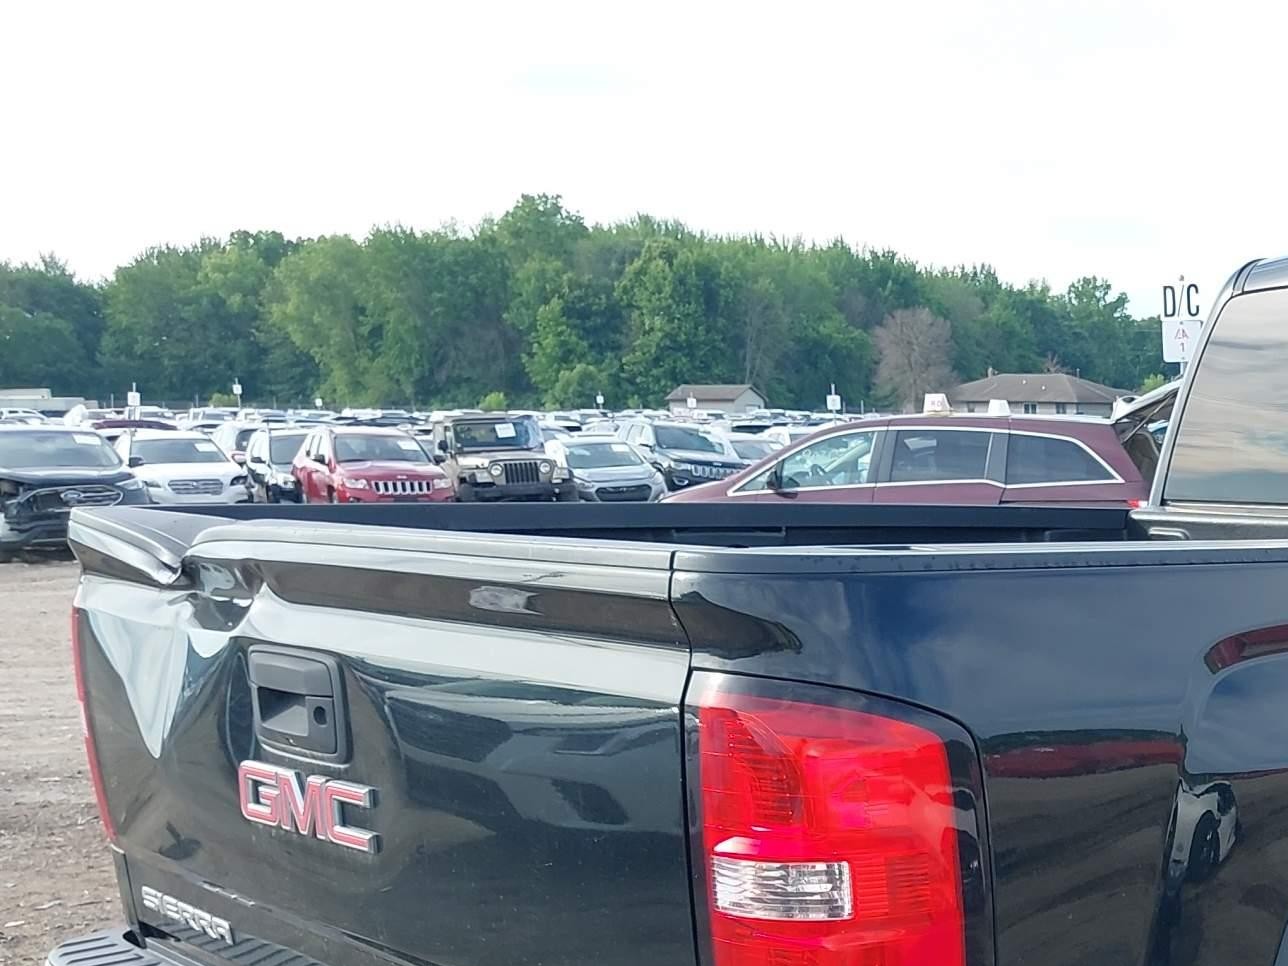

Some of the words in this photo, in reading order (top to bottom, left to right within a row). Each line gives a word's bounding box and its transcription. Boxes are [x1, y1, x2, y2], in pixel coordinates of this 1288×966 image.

[1162, 284, 1200, 318] D/C
[239, 759, 381, 855] GMC
[141, 885, 235, 946] SIERRA
